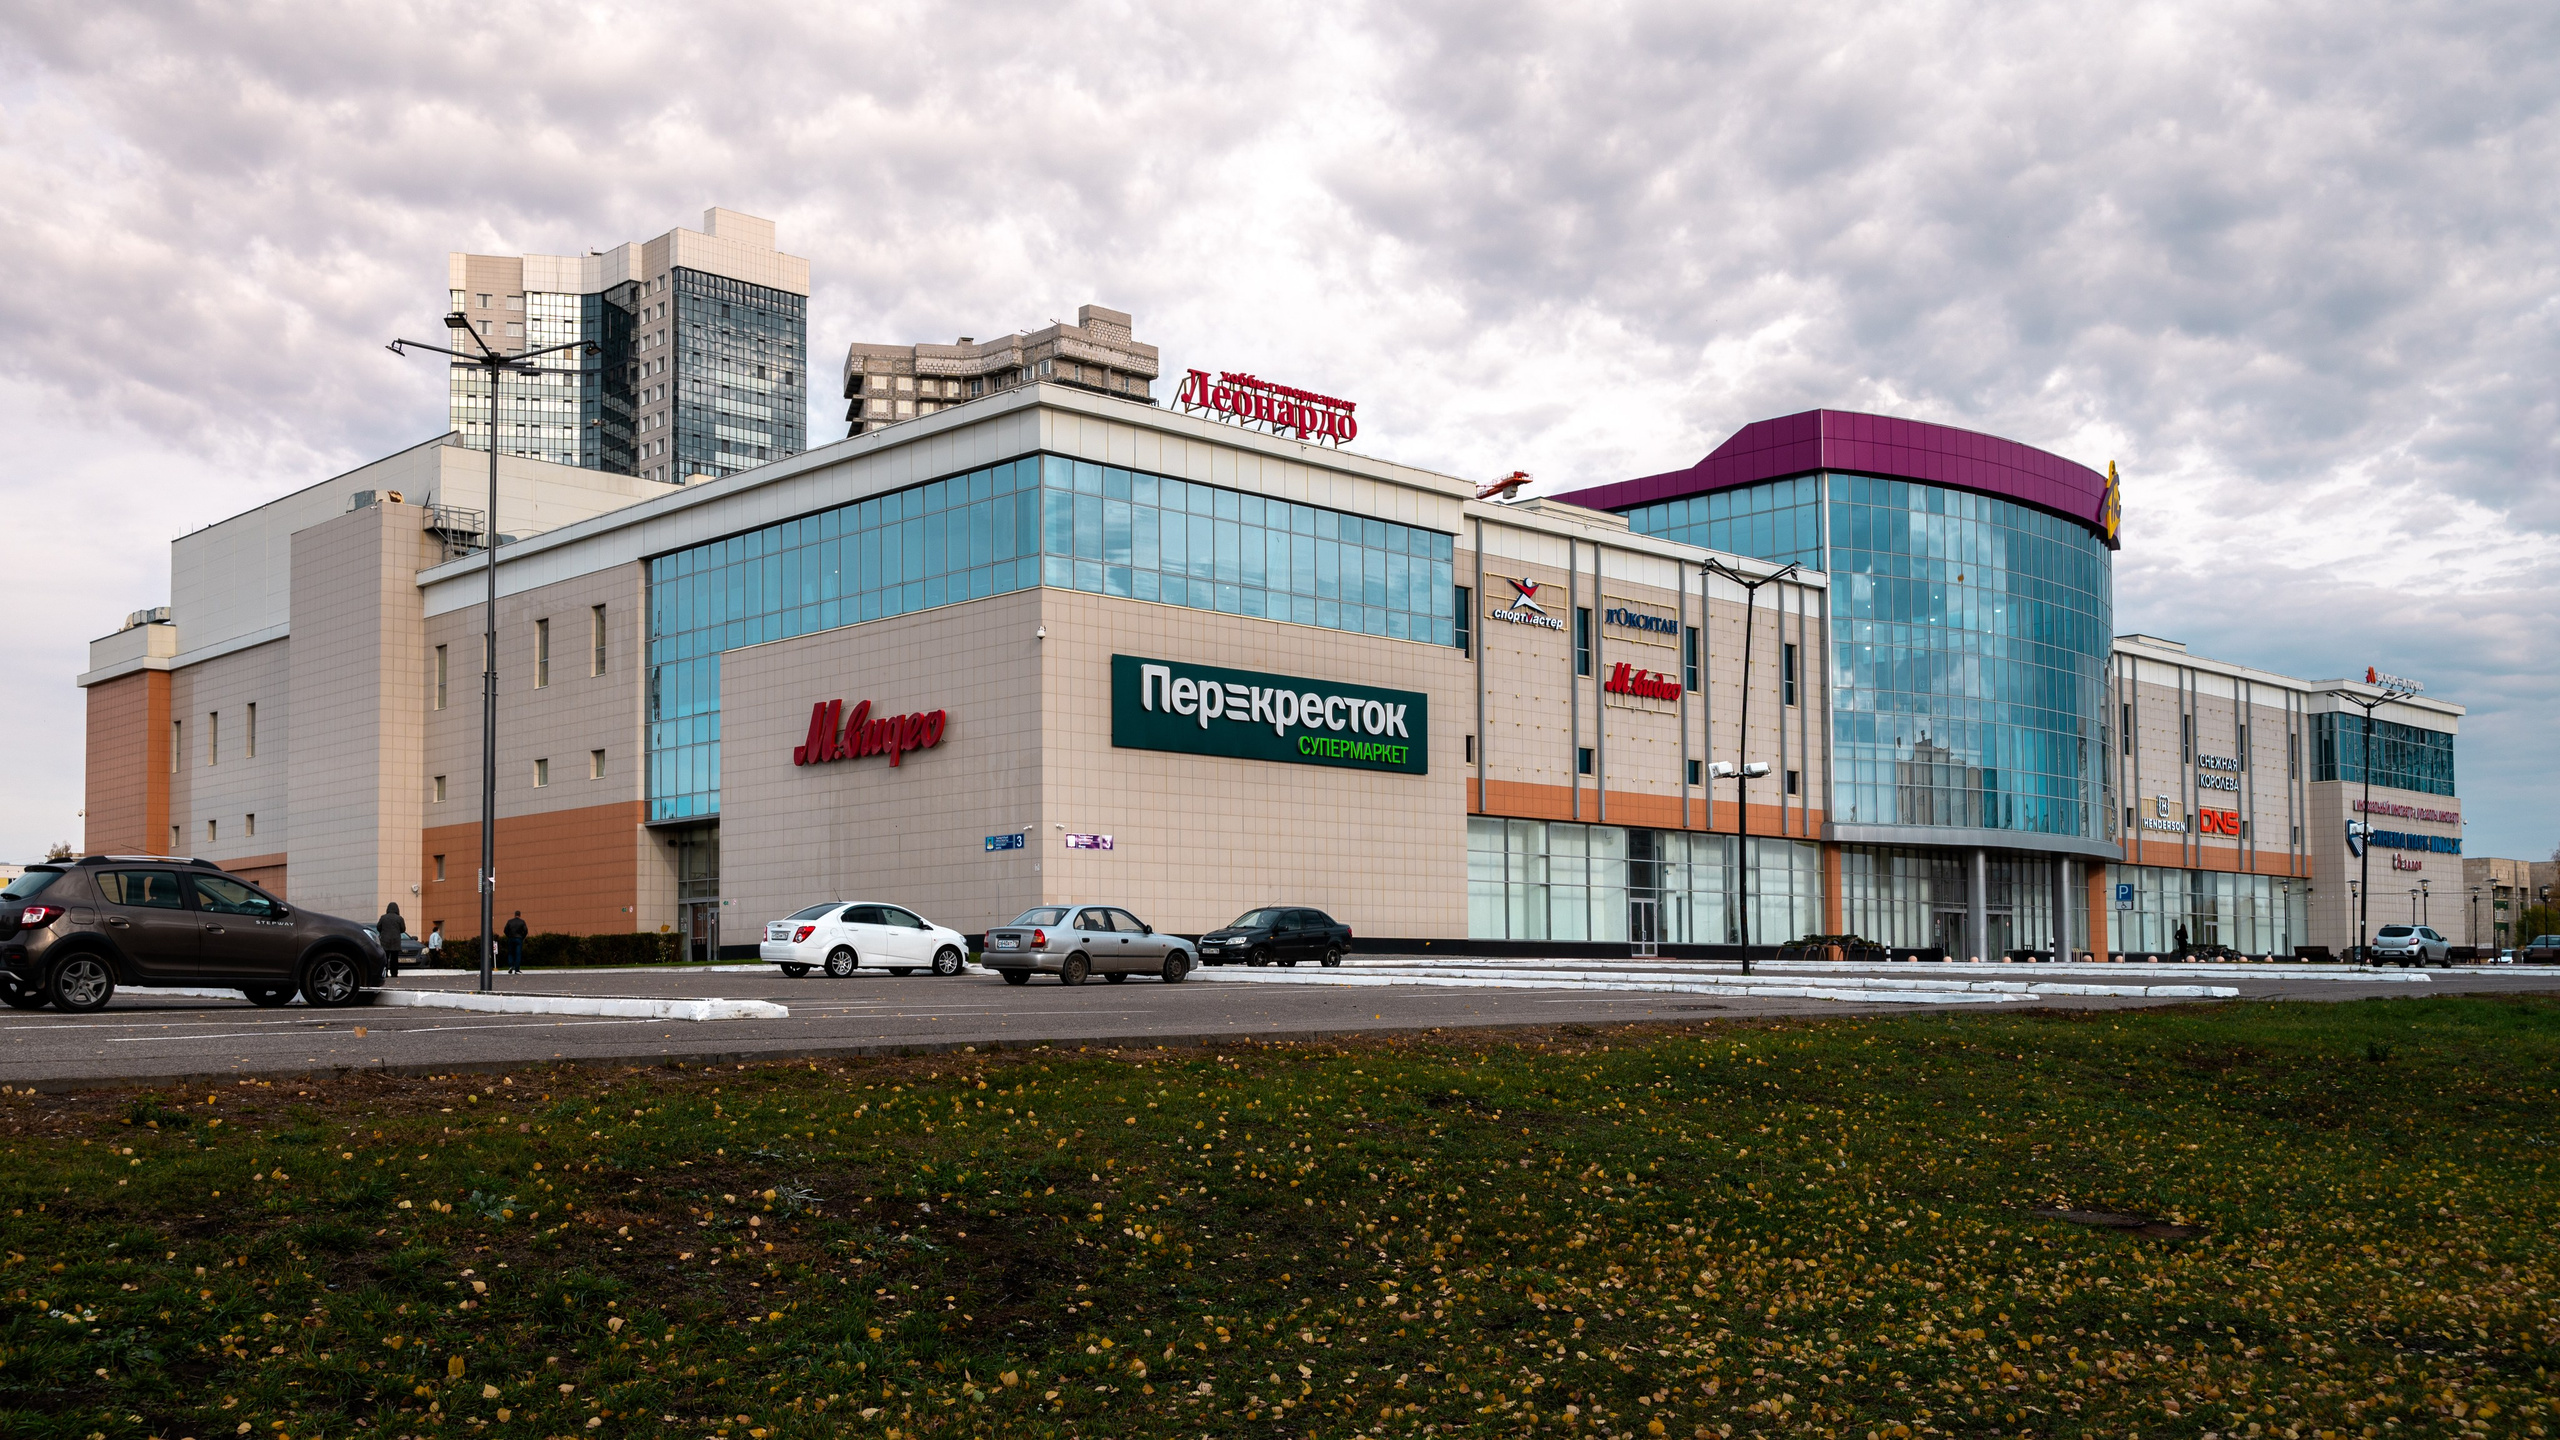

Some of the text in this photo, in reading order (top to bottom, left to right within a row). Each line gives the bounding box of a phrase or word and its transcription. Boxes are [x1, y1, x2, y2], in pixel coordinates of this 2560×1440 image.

[1220, 371, 1356, 412] хобби-гипермаркет
[1181, 368, 1358, 443] Леонардо
[1141, 663, 1409, 738] Перекресток
[1299, 736, 1409, 764] СУПЕРМАРКЕТ
[2199, 753, 2238, 772] СНЕЖНАЯ
[2200, 773, 2239, 791] КОРОЛЕВА
[2143, 818, 2186, 832] HENDERSON
[2200, 808, 2240, 835] DNS
[1016, 835, 1023, 848] 3
[2430, 835, 2462, 854] IMAX
[2119, 885, 2129, 899] P
